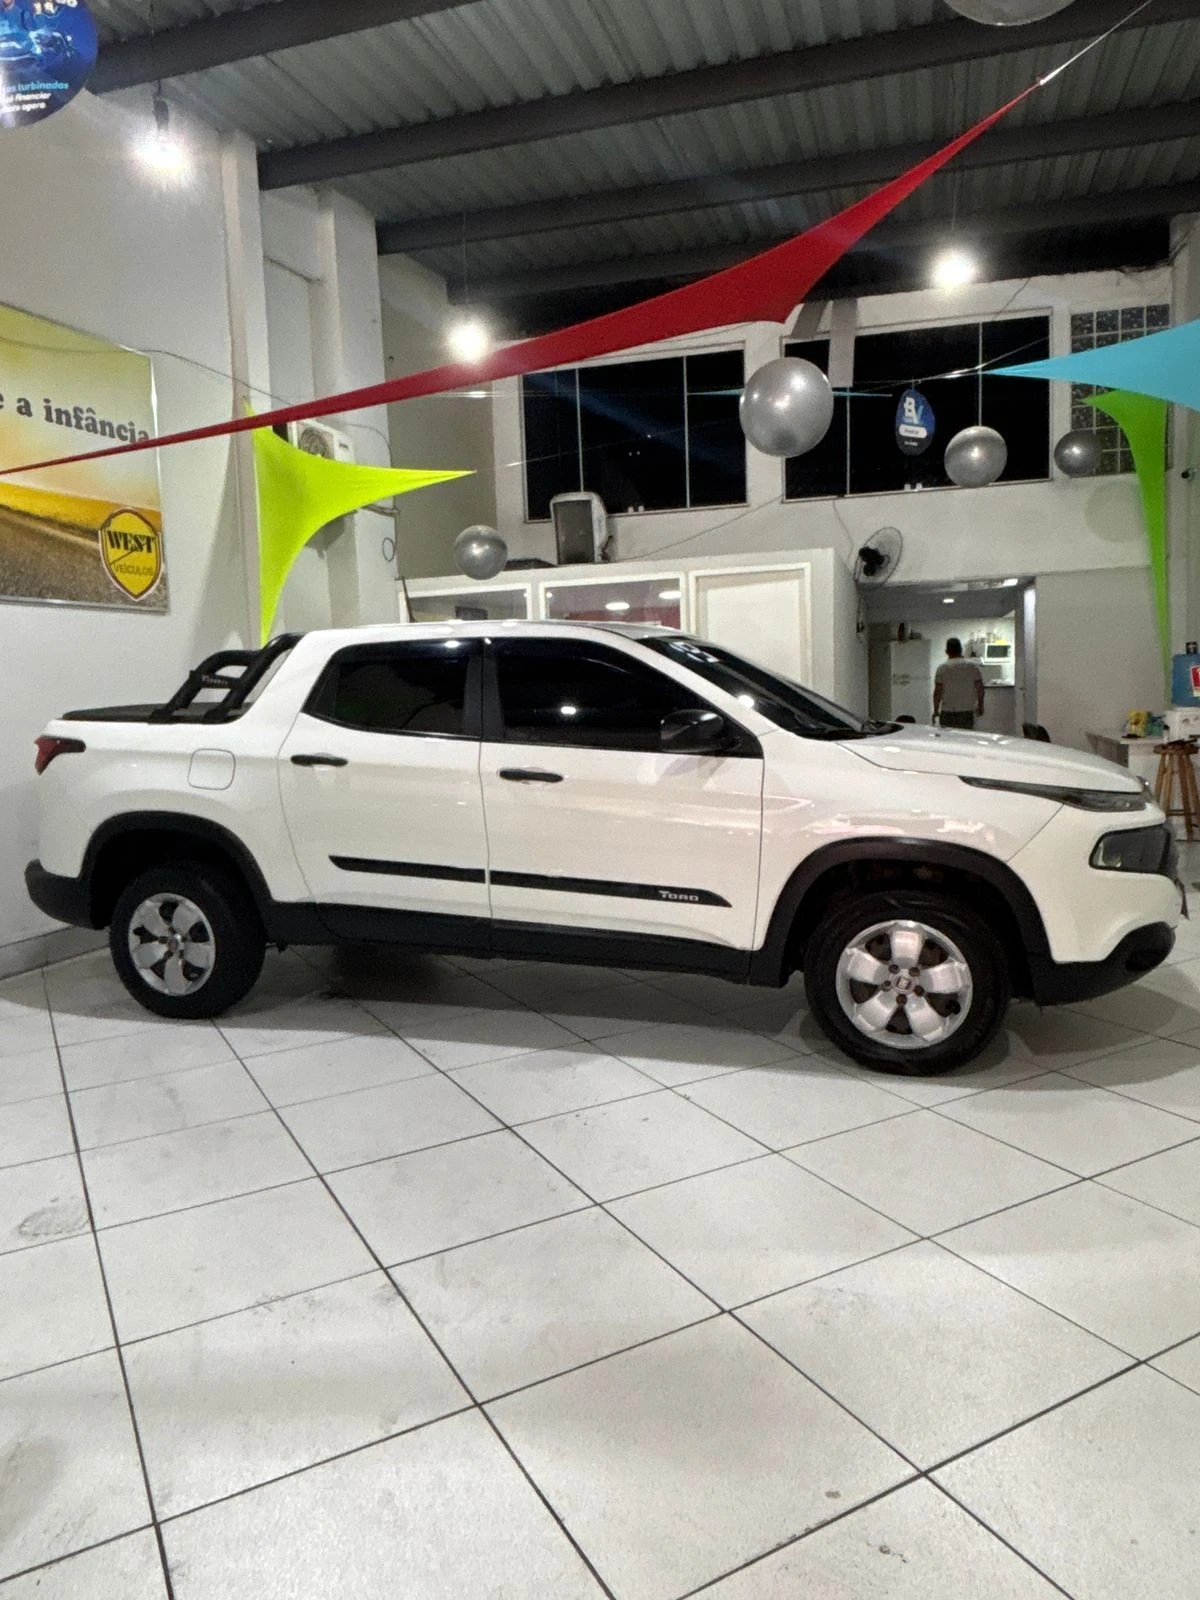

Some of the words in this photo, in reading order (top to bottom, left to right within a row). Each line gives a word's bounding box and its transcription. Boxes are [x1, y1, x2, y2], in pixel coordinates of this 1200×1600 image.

[16, 397, 33, 418] a
[43, 397, 149, 442] infância
[107, 530, 157, 553] WEST
